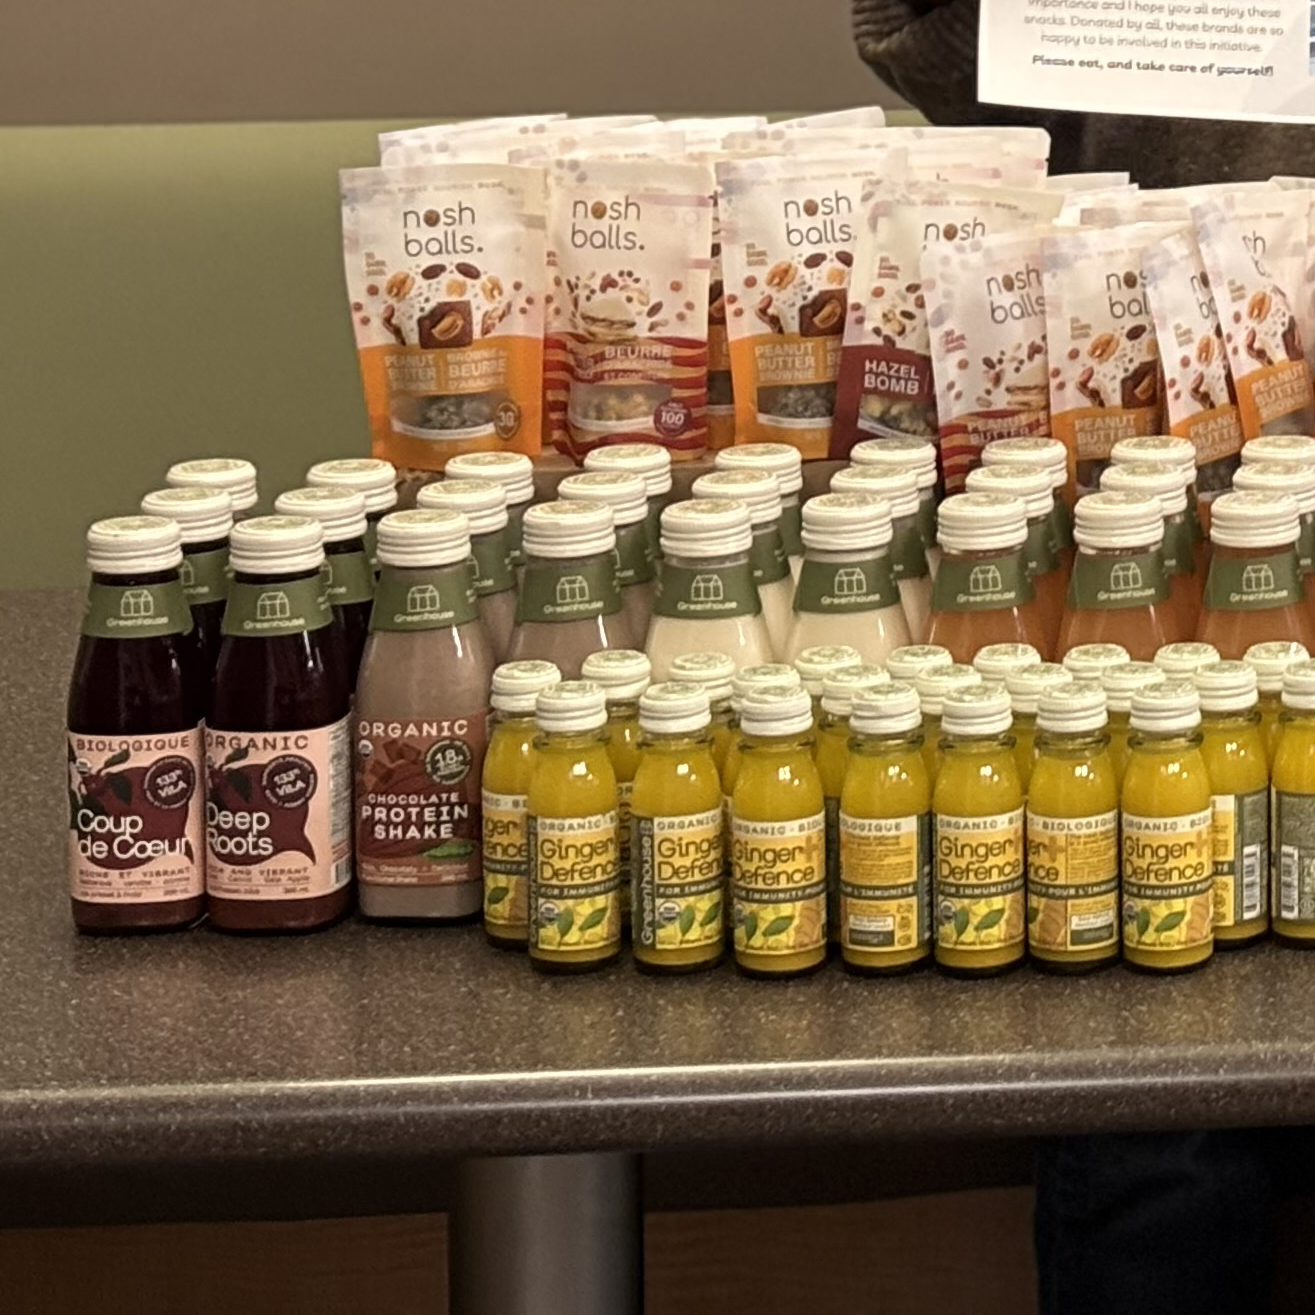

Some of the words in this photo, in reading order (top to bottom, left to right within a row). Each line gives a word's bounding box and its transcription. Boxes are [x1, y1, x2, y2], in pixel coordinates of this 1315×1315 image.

[1077, 59, 1104, 70] eat,
[1106, 59, 1132, 70] and
[1135, 60, 1165, 72] take
[1167, 63, 1197, 73] care
[1199, 62, 1215, 74] of
[573, 195, 640, 222] nosh
[784, 191, 852, 218] nosh
[403, 202, 475, 228] nosh
[571, 223, 645, 250] balls.
[924, 217, 986, 241] nosh
[404, 231, 483, 256] balls.
[755, 342, 815, 358] PEANUT
[757, 356, 815, 370] BUTTER
[864, 359, 920, 380] HAZEL
[864, 375, 920, 394] BOMB
[660, 411, 685, 426] 100
[1075, 416, 1136, 432] PEANUT
[678, 599, 738, 611] Greenhouse
[957, 590, 1016, 603] Greenhouse
[107, 616, 169, 628] Greenhouse
[244, 618, 306, 630] Greenhouse
[394, 610, 455, 624] Greenhouse
[359, 720, 469, 737] ORGANIC
[76, 736, 190, 752] BIOLOGIQUE
[368, 793, 460, 805] CHOCOLATE
[77, 809, 143, 835] Coup
[362, 805, 470, 823] PROTEIN
[374, 823, 454, 840] SHAKE
[78, 838, 109, 858] de
[734, 839, 804, 867] Ginger
[939, 835, 1013, 863] Ginger
[1124, 836, 1196, 864] Ginger
[733, 863, 816, 887] Defence
[938, 860, 1021, 882] Defence
[1124, 860, 1205, 882] Defence
